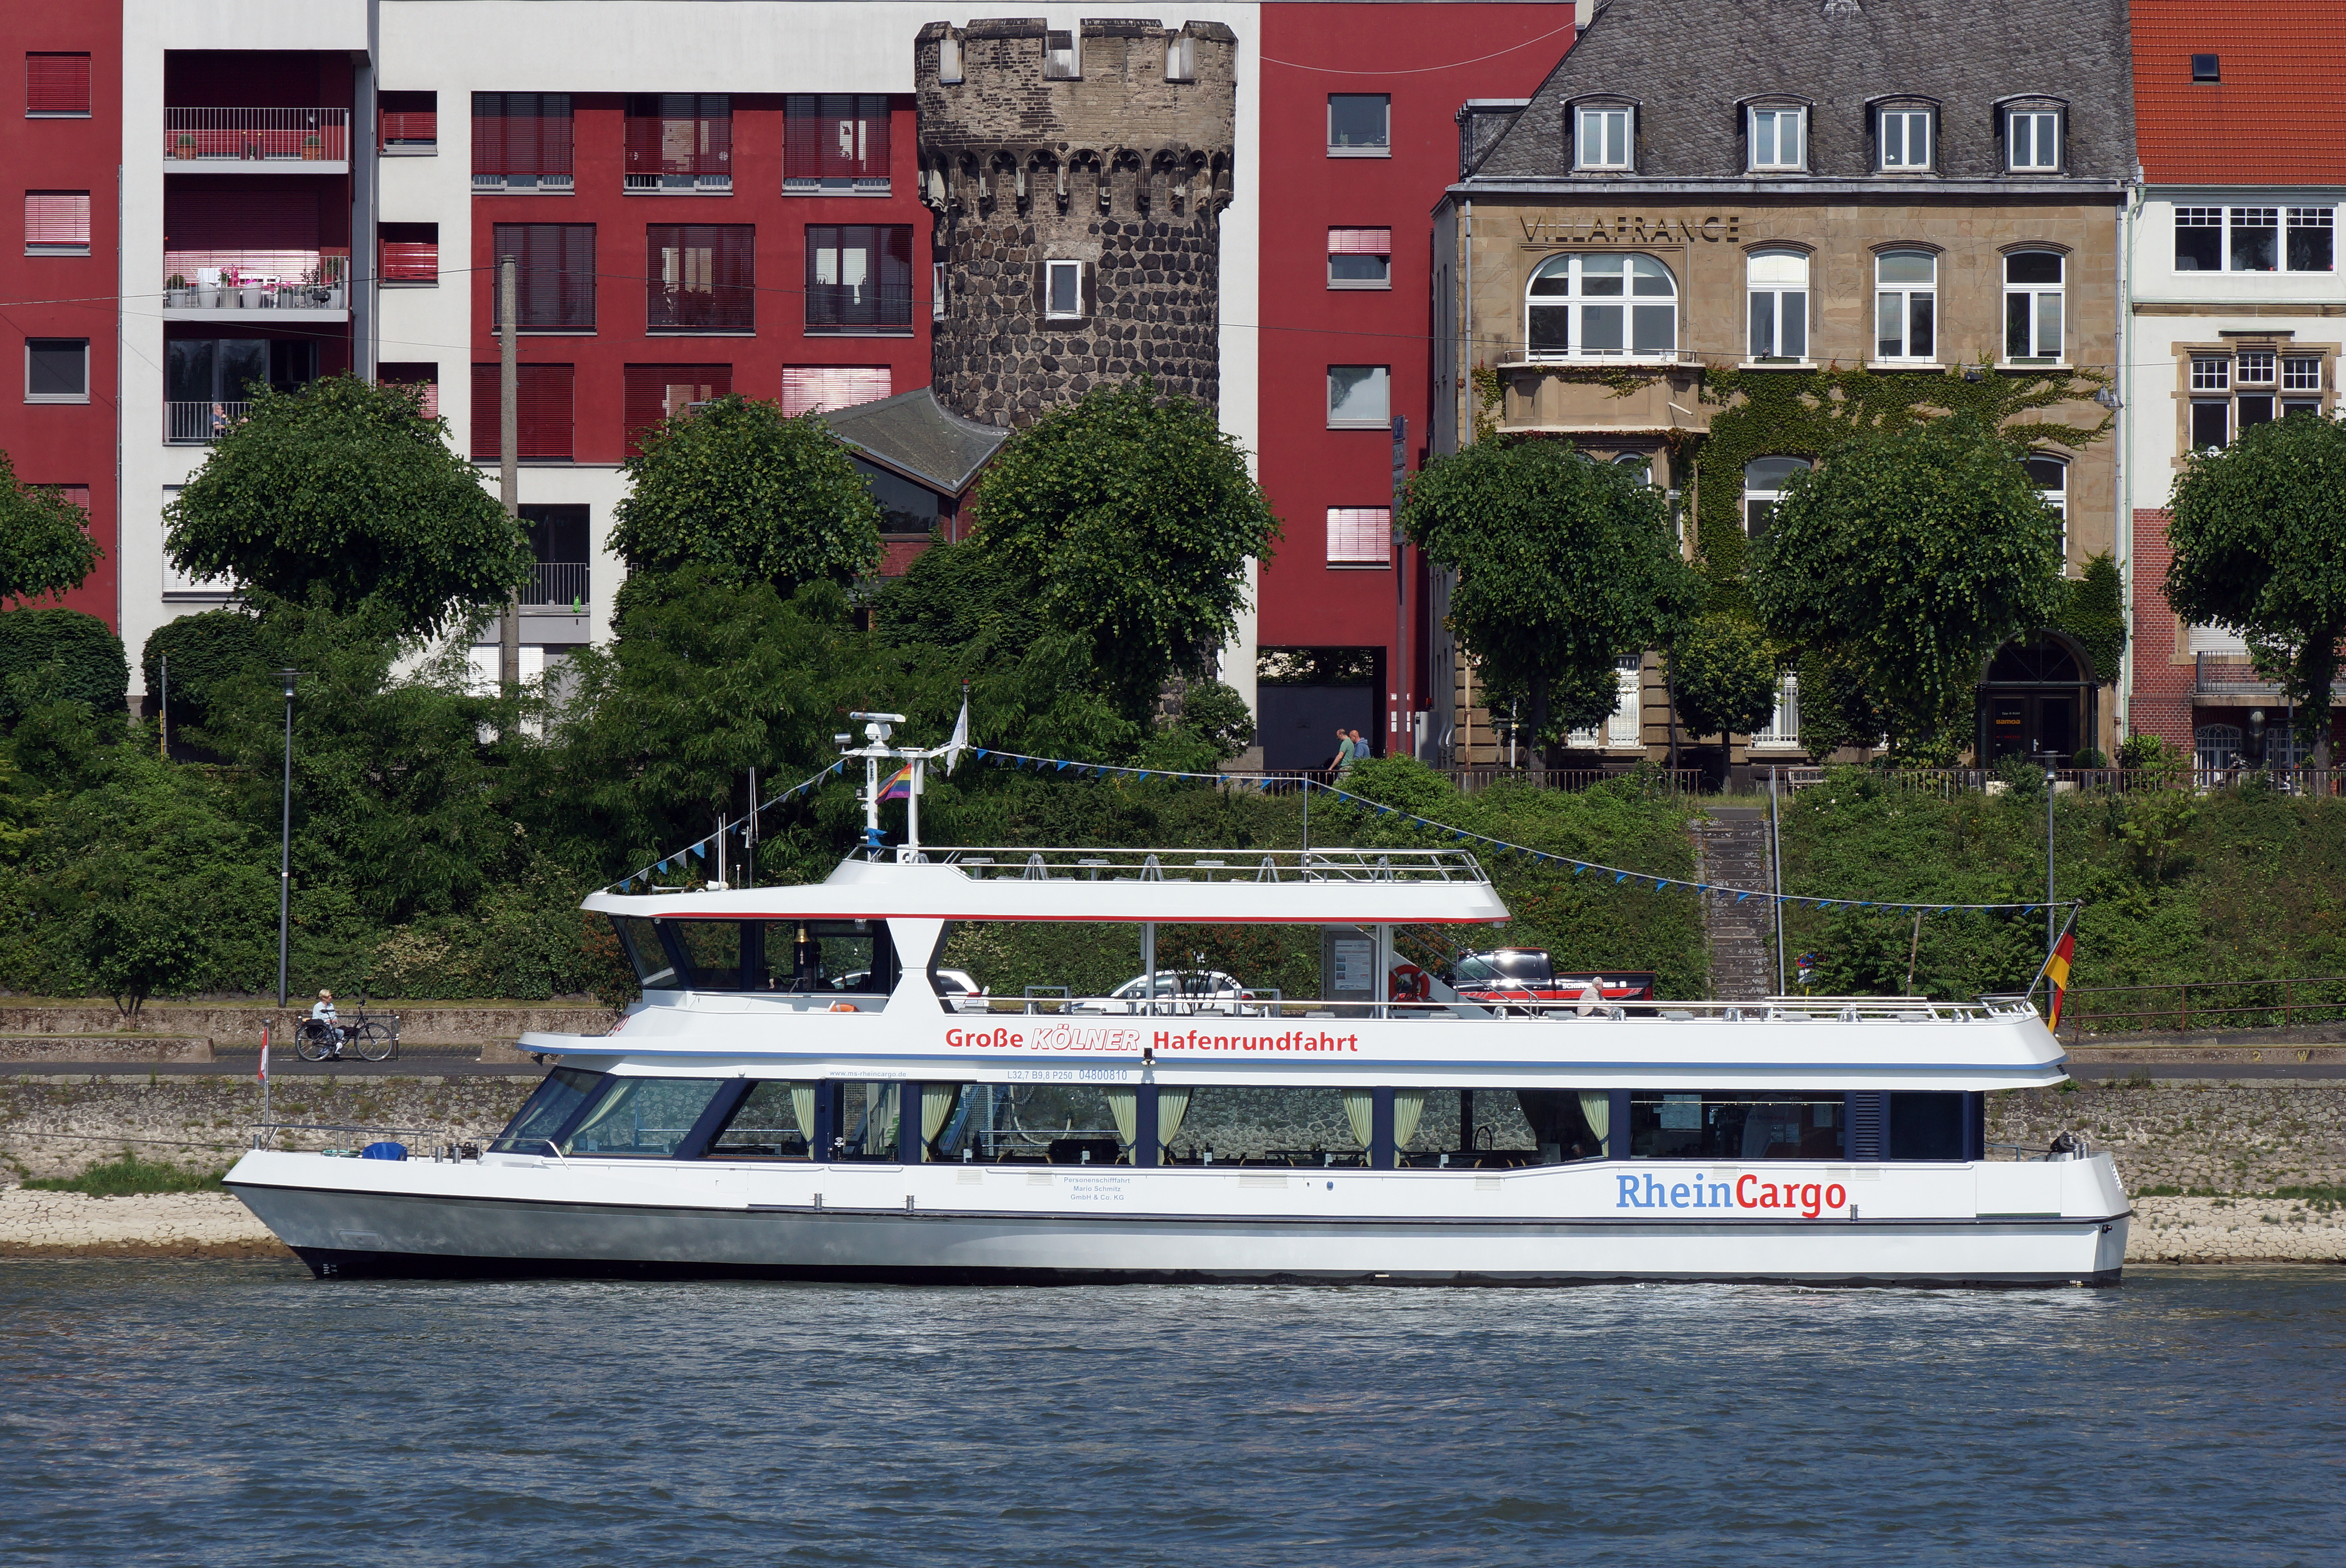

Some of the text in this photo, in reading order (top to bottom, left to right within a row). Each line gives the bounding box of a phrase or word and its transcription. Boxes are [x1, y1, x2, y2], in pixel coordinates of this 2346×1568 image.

[945, 1024, 1358, 1052] Große KÖLNER Hafenrundfahrt
[829, 1070, 907, 1078] www.ms-rheincargo.de
[1007, 1069, 1127, 1080] L32,7 B9,8 P250 04800810
[1616, 1173, 1846, 1219] RheinCargo
